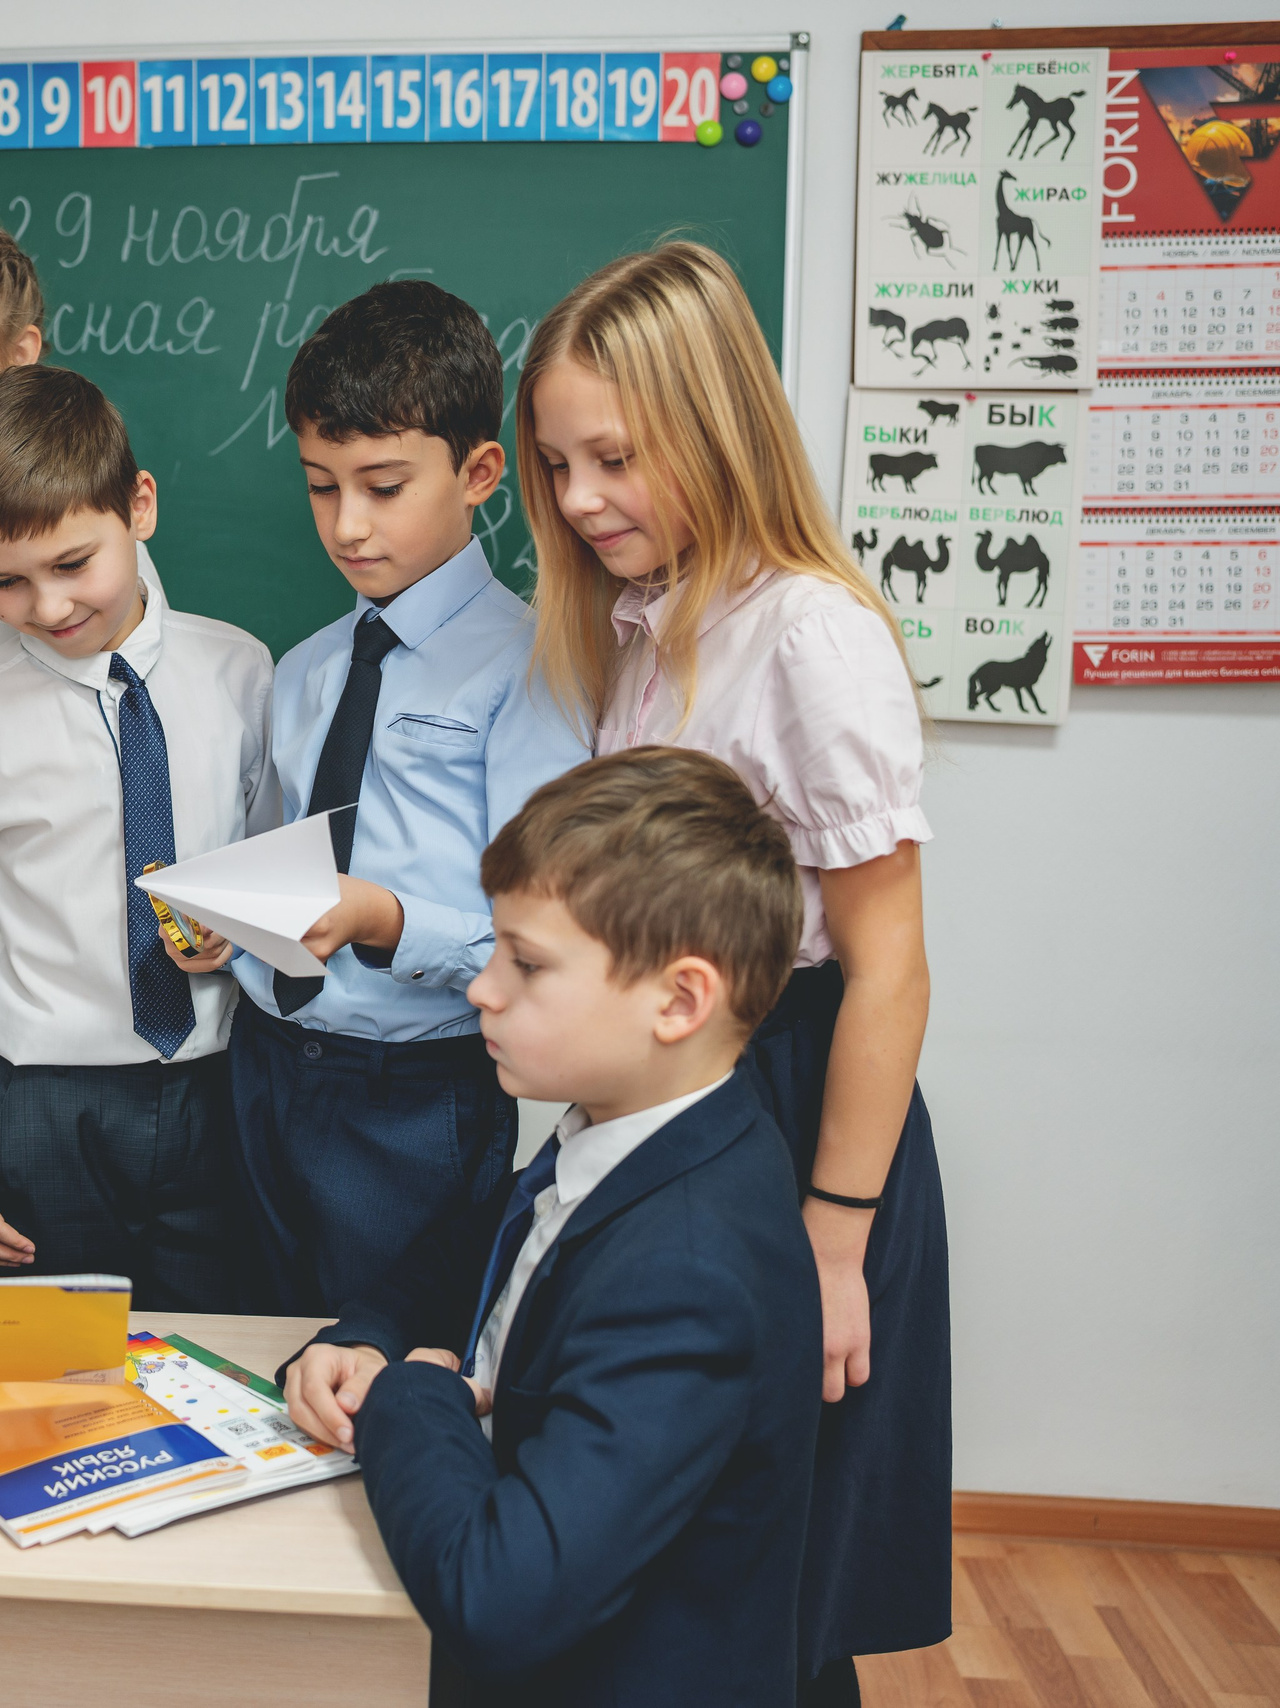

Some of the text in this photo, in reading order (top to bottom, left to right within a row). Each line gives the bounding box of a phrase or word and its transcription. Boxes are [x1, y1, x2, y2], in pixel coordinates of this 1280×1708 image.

[881, 63, 978, 79] ЖЕРЕБЯТА
[991, 59, 1090, 76] ЖЕРЕБЁНОК
[43, 78, 69, 134] 9
[88, 77, 131, 133] 10
[144, 76, 183, 131] 11
[202, 74, 246, 130] 12
[259, 73, 303, 129] 13
[317, 72, 365, 128] 14
[375, 70, 420, 128] 15
[433, 70, 481, 127] 16
[492, 70, 538, 126] 17
[550, 69, 597, 127] 18
[608, 68, 656, 126] 19
[663, 68, 717, 126] 20
[1103, 69, 1140, 223] FORIN
[876, 171, 977, 187] ЖУЖЕЛИЦА
[1014, 186, 1088, 201] ЖИРАФ
[120, 171, 390, 300] ноября
[875, 283, 973, 298] ЖУРАВЛИ
[1002, 279, 1059, 294] ЖУКИ
[1127, 291, 1137, 302] 3
[1156, 290, 1166, 300] 4
[1185, 289, 1195, 301] 5
[1213, 289, 1223, 301] 6
[1243, 288, 1252, 299] 7
[1124, 307, 1142, 319] 10
[1153, 307, 1168, 317] 11
[1181, 306, 1198, 318] 12
[1209, 306, 1227, 318] 13
[1238, 305, 1255, 316] 14
[1123, 324, 1140, 335] 17
[1152, 324, 1169, 335] 18
[1181, 323, 1198, 335] 19
[1207, 323, 1226, 334] 20
[1235, 322, 1253, 334] 21
[1121, 341, 1140, 353] 24
[1150, 340, 1169, 352] 25
[1178, 340, 1196, 352] 26
[1206, 339, 1225, 352] 27
[1235, 339, 1254, 351] 28
[987, 403, 1056, 427] БЫК
[1125, 411, 1275, 425] 1 2 3 4 5 6
[863, 426, 928, 444] БЫКИ
[1122, 430, 1132, 442] 8
[1151, 430, 1161, 441] 9
[1176, 429, 1194, 441] 10
[1205, 429, 1220, 439] 11
[1233, 428, 1251, 440] 12
[1120, 447, 1136, 458] 15
[1148, 447, 1164, 458] 16
[1175, 446, 1192, 457] 17
[1204, 446, 1221, 457] 18
[1233, 445, 1250, 457] 19
[1117, 461, 1278, 475] 22 23 24 25 26 27
[1116, 479, 1190, 492] 29 30 31
[858, 506, 958, 523] ВЕРБЛЮДЫ
[969, 508, 1063, 527] ВЕРБЛЮД
[1119, 549, 1268, 561] 1 2 3 4 5 6
[1117, 565, 1272, 578] 8 9 10 11 12 13
[1115, 582, 1272, 594] 15 16 17 18 19 20
[1112, 598, 1270, 610] 22 23 24 25 26 27
[964, 618, 1025, 637] ВОЛК
[1112, 615, 1185, 627] 29 30 31
[903, 620, 931, 638] СЬ
[1112, 649, 1155, 663] FORIN
[51, 1443, 138, 1477] ЯЗЫК
[42, 1448, 174, 1499] РУССКИЙ
